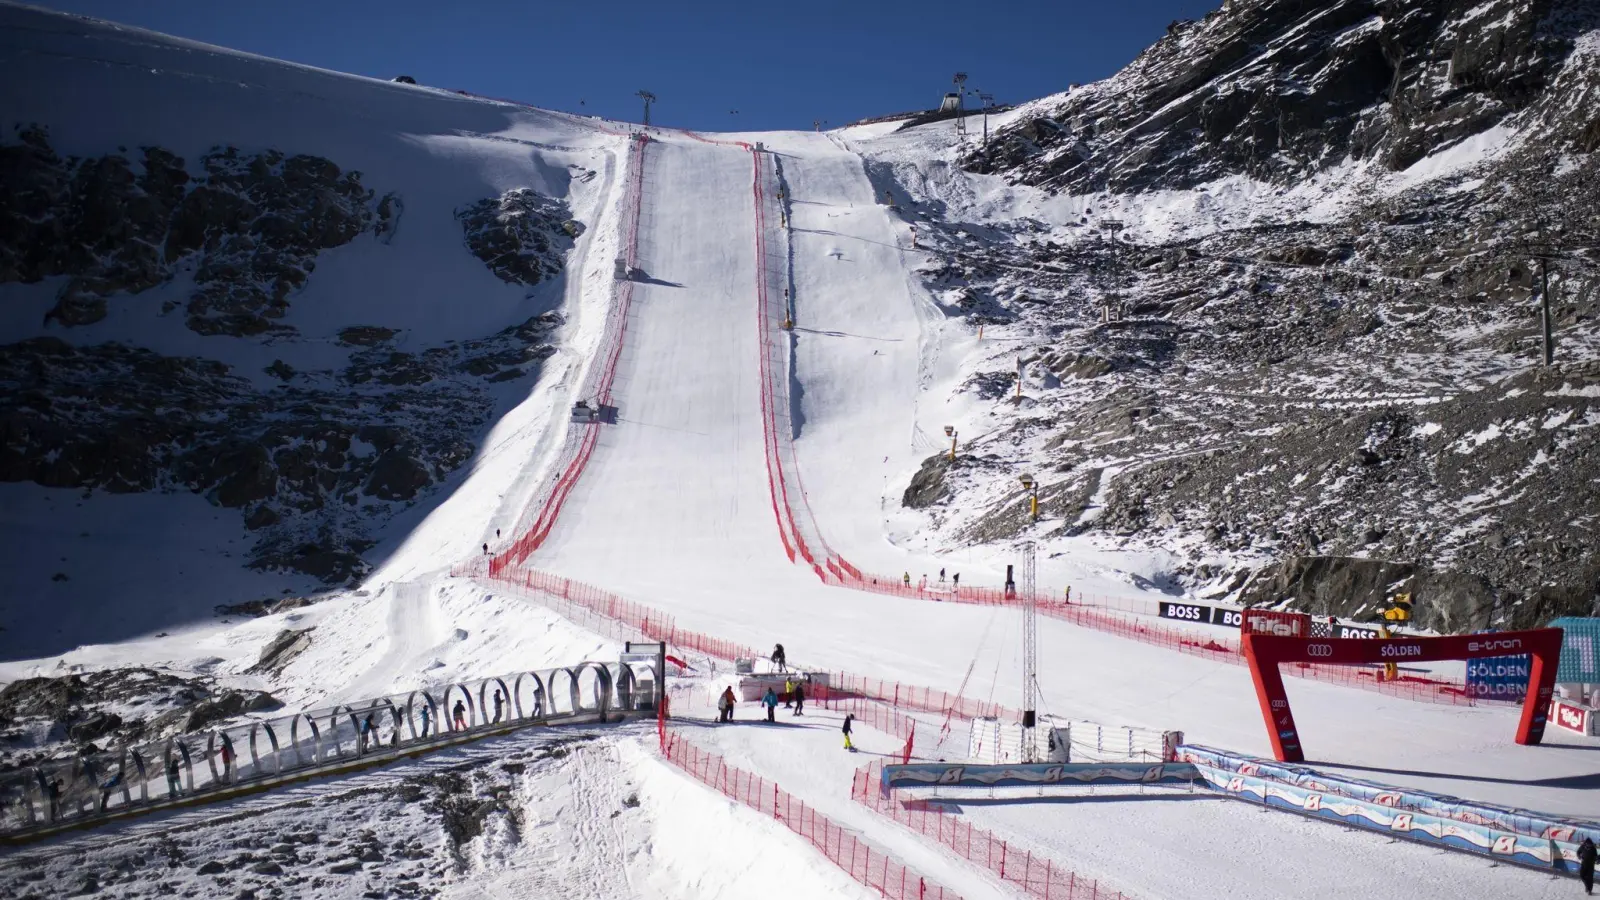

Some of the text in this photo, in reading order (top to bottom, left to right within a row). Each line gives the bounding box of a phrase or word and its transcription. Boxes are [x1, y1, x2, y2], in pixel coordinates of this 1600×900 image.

[1168, 605, 1200, 619] BOSS
[1224, 612, 1242, 625] BO
[1381, 644, 1421, 656] SÖLDEN
[1468, 639, 1521, 651] e-tron
[1469, 663, 1527, 676] SÖLDEN
[1468, 681, 1527, 694] SÖLDEN
